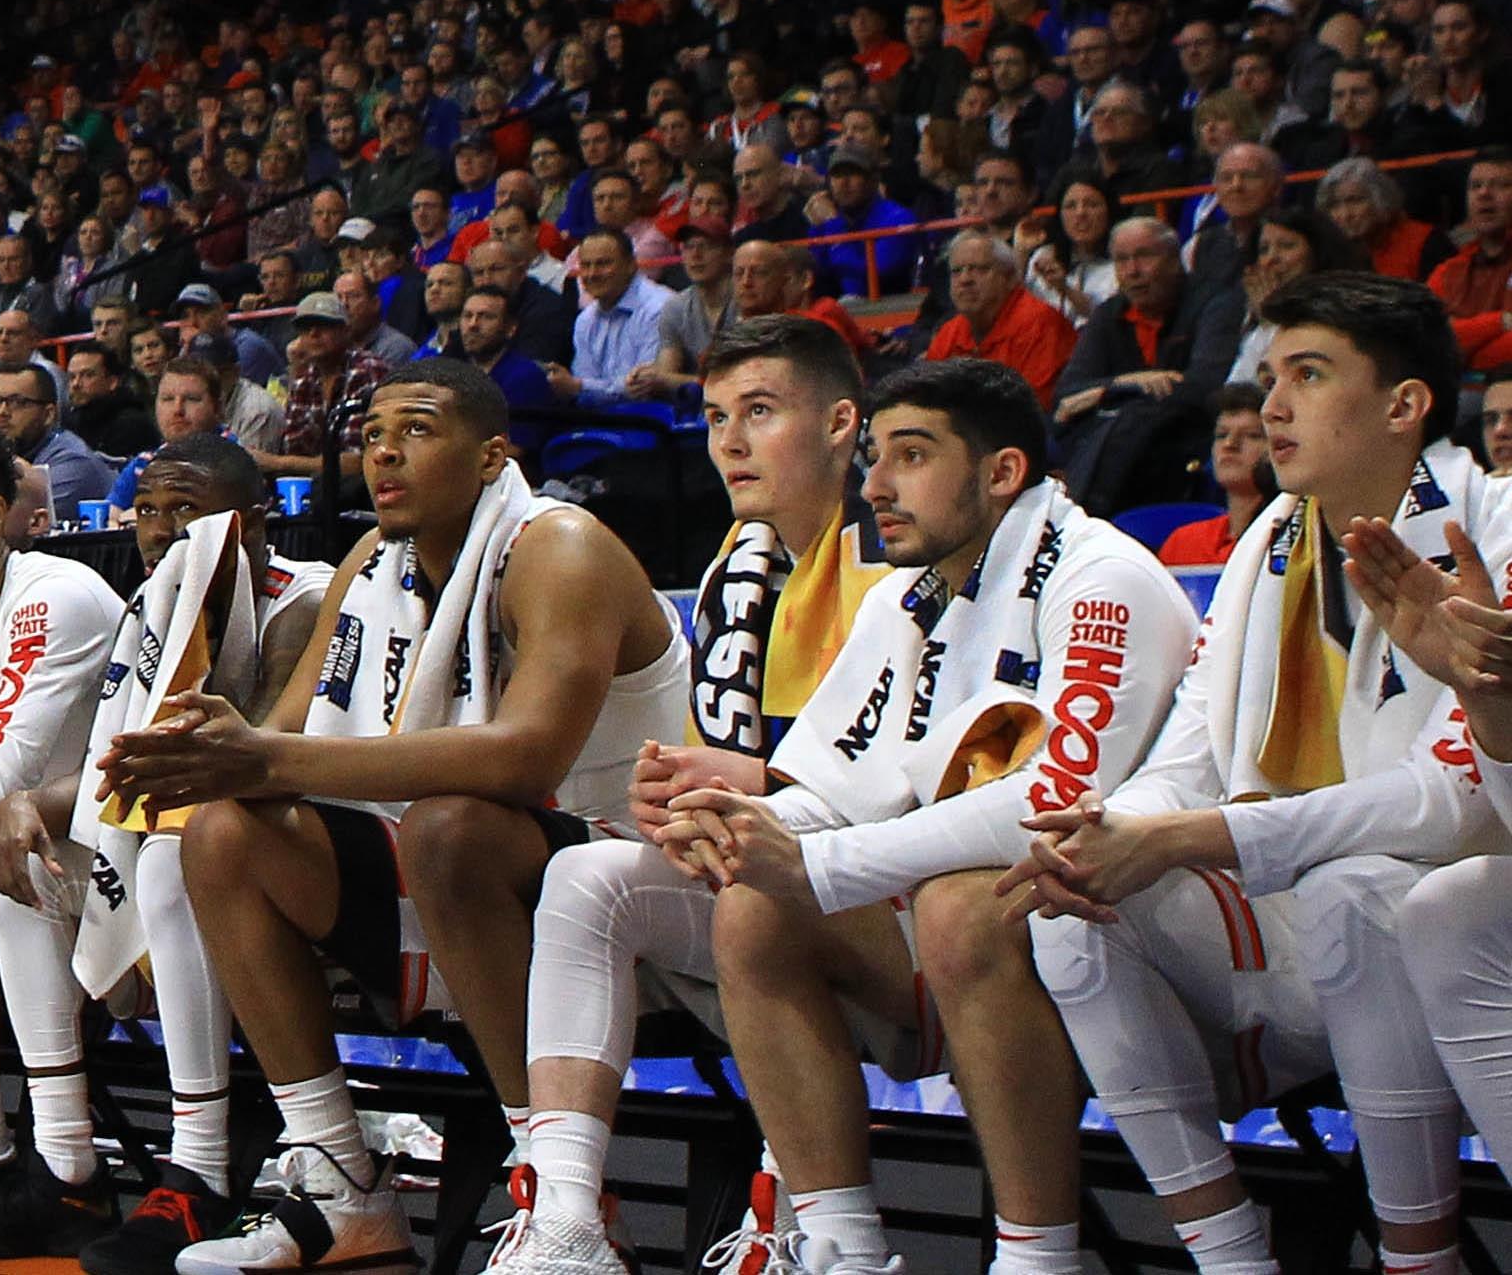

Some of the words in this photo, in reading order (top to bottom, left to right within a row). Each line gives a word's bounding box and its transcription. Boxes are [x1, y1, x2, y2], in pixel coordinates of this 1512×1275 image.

[11, 601, 49, 625] OHIO
[1073, 600, 1130, 624] OHIO
[334, 617, 362, 682] MADNESS
[1069, 623, 1127, 649] STATE
[319, 635, 344, 682] MARCH
[833, 666, 895, 762] NCAA
